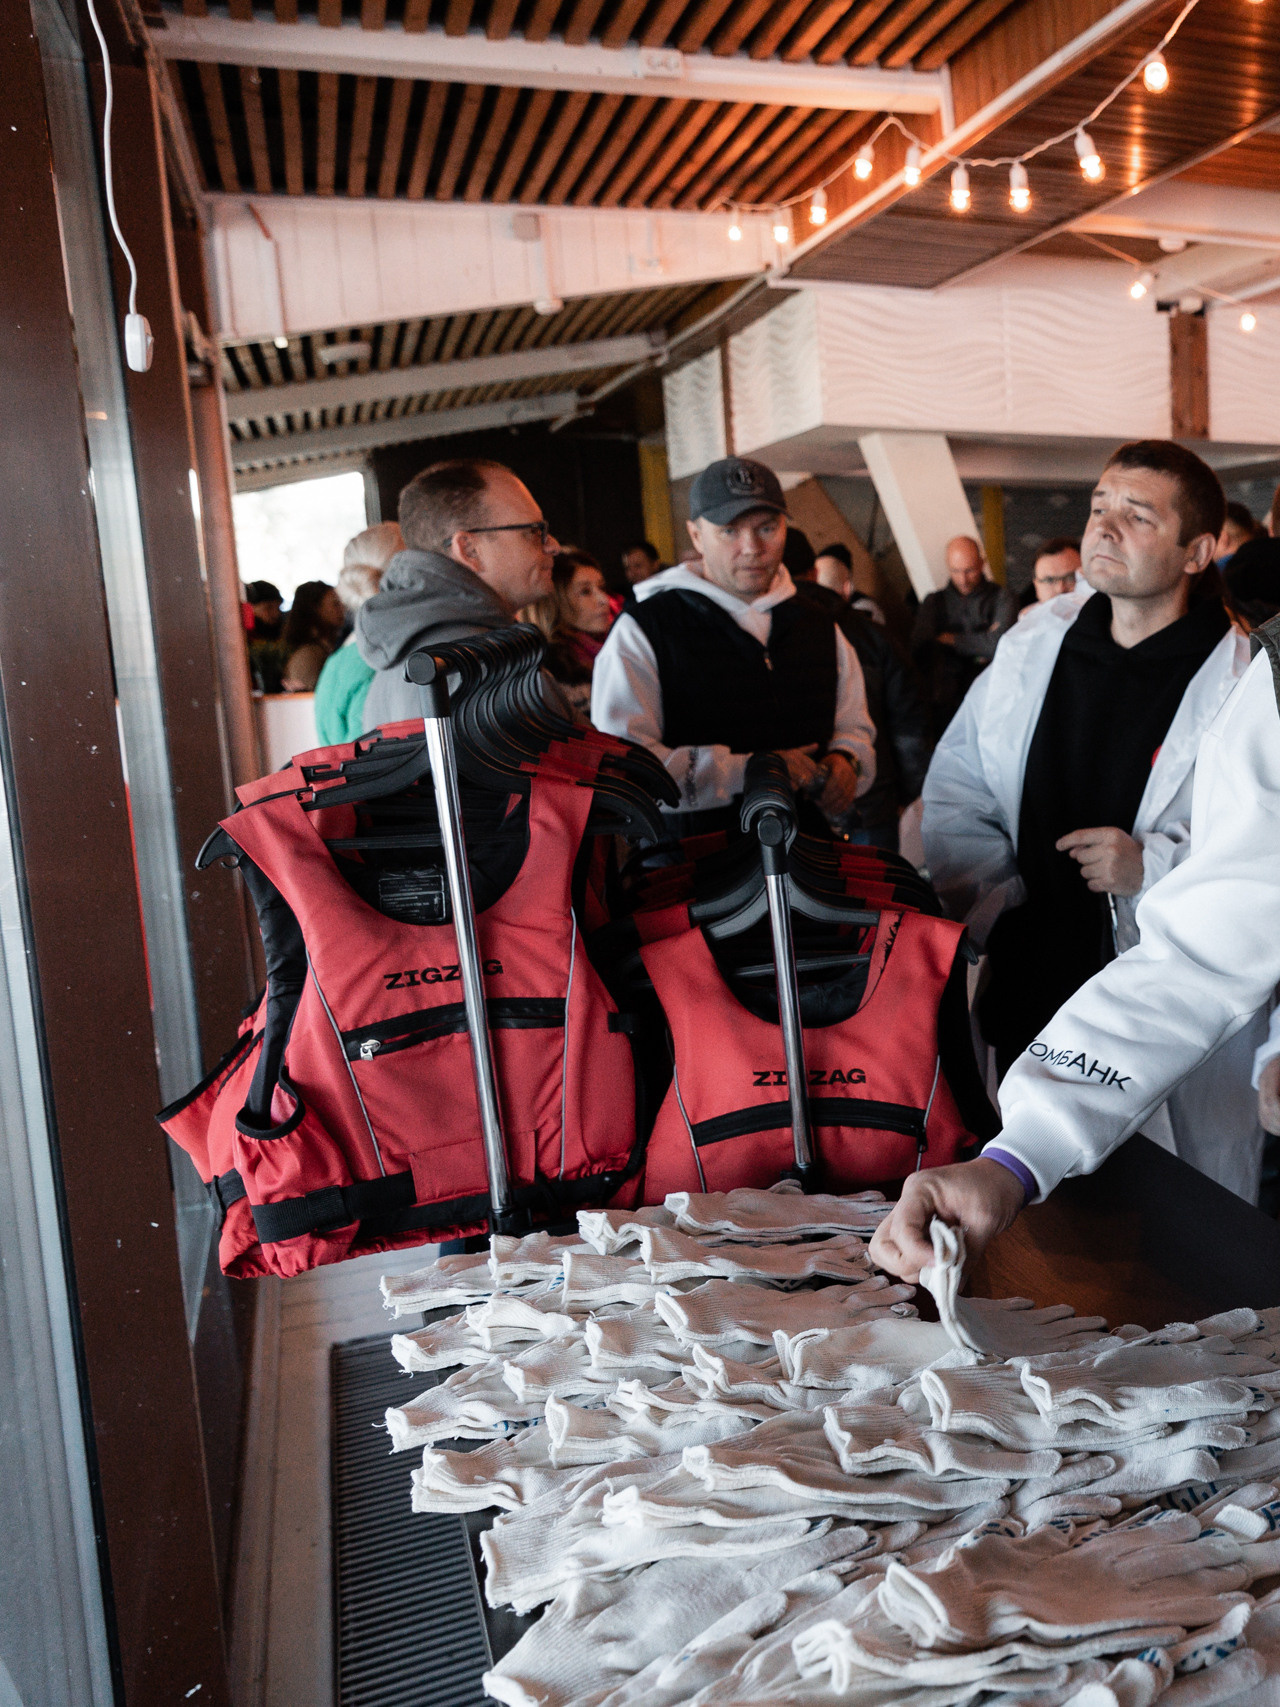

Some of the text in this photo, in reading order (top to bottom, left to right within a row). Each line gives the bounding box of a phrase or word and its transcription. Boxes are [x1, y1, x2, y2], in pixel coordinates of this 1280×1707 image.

[384, 959, 503, 990] ZIGZG
[753, 1068, 867, 1086] ZIZAG
[1029, 1041, 1132, 1092] ОМБАНК
